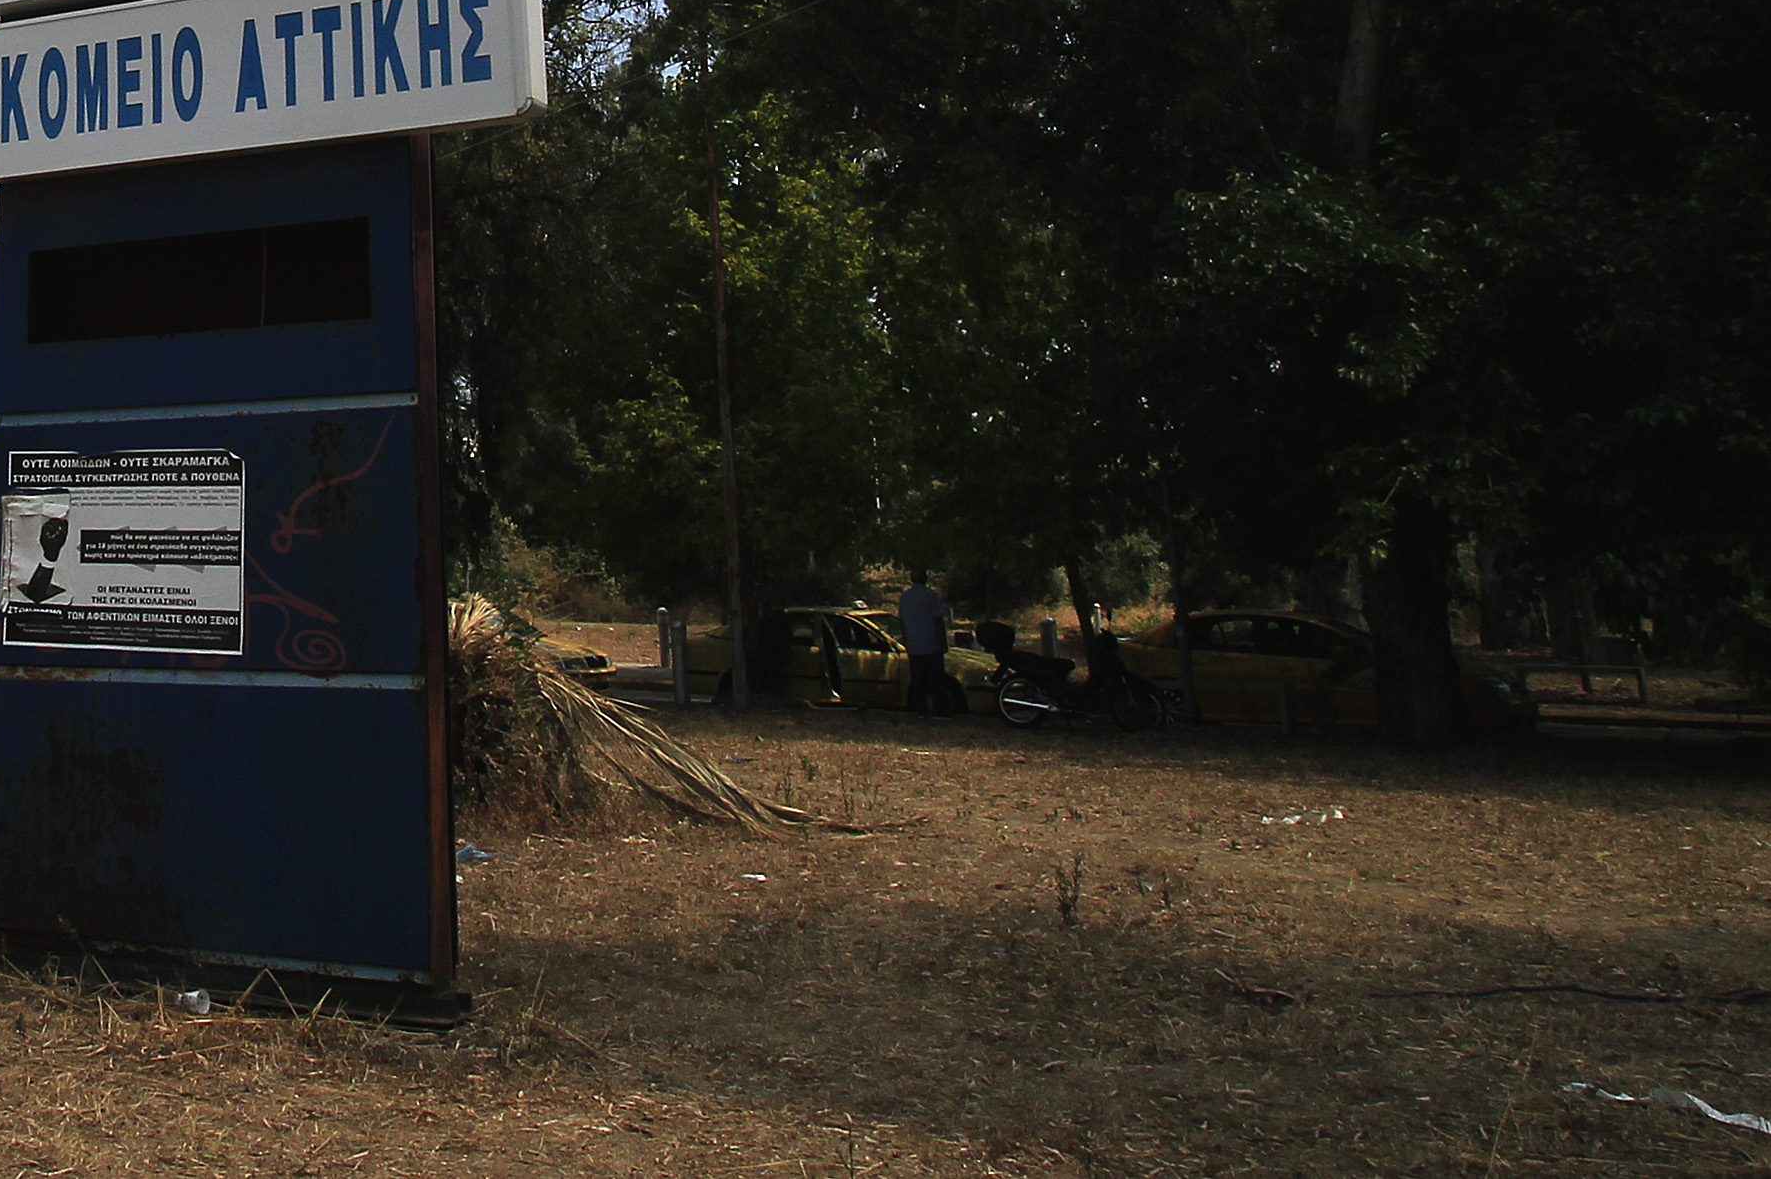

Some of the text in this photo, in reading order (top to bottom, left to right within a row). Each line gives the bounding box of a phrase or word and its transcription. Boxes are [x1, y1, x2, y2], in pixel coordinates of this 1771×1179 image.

[22, 458, 50, 469] ΟΥΤΕ
[120, 457, 149, 467] ΟΥΤΕ
[152, 456, 230, 467] ΣΚΑΡΑΜΑΓΚΑ
[13, 474, 73, 483] ΣΤΡΑΤΟΠΕΔΑ
[75, 473, 149, 482] ΣΥΓΚΕΝΤΡΩΣΗΣ
[151, 473, 178, 481] ΠΟΤΕ
[180, 473, 188, 481] &
[97, 585, 191, 595] ΟΙ ΜΕΤΑΝΑΣΤΕΣ ΕΙΝΑΙ
[91, 596, 108, 604] ΤΗΣ
[128, 597, 138, 605] ΟΙ
[139, 597, 197, 607] ΚΟΛΑΣΜΕΝΟΙ
[67, 611, 85, 620] ΤΩΝ
[142, 613, 182, 624] ΕΙΜΑΣΤΕ
[184, 615, 207, 625] ΟΛΟΙ
[209, 615, 239, 626] ΞΕΝΟΙ
